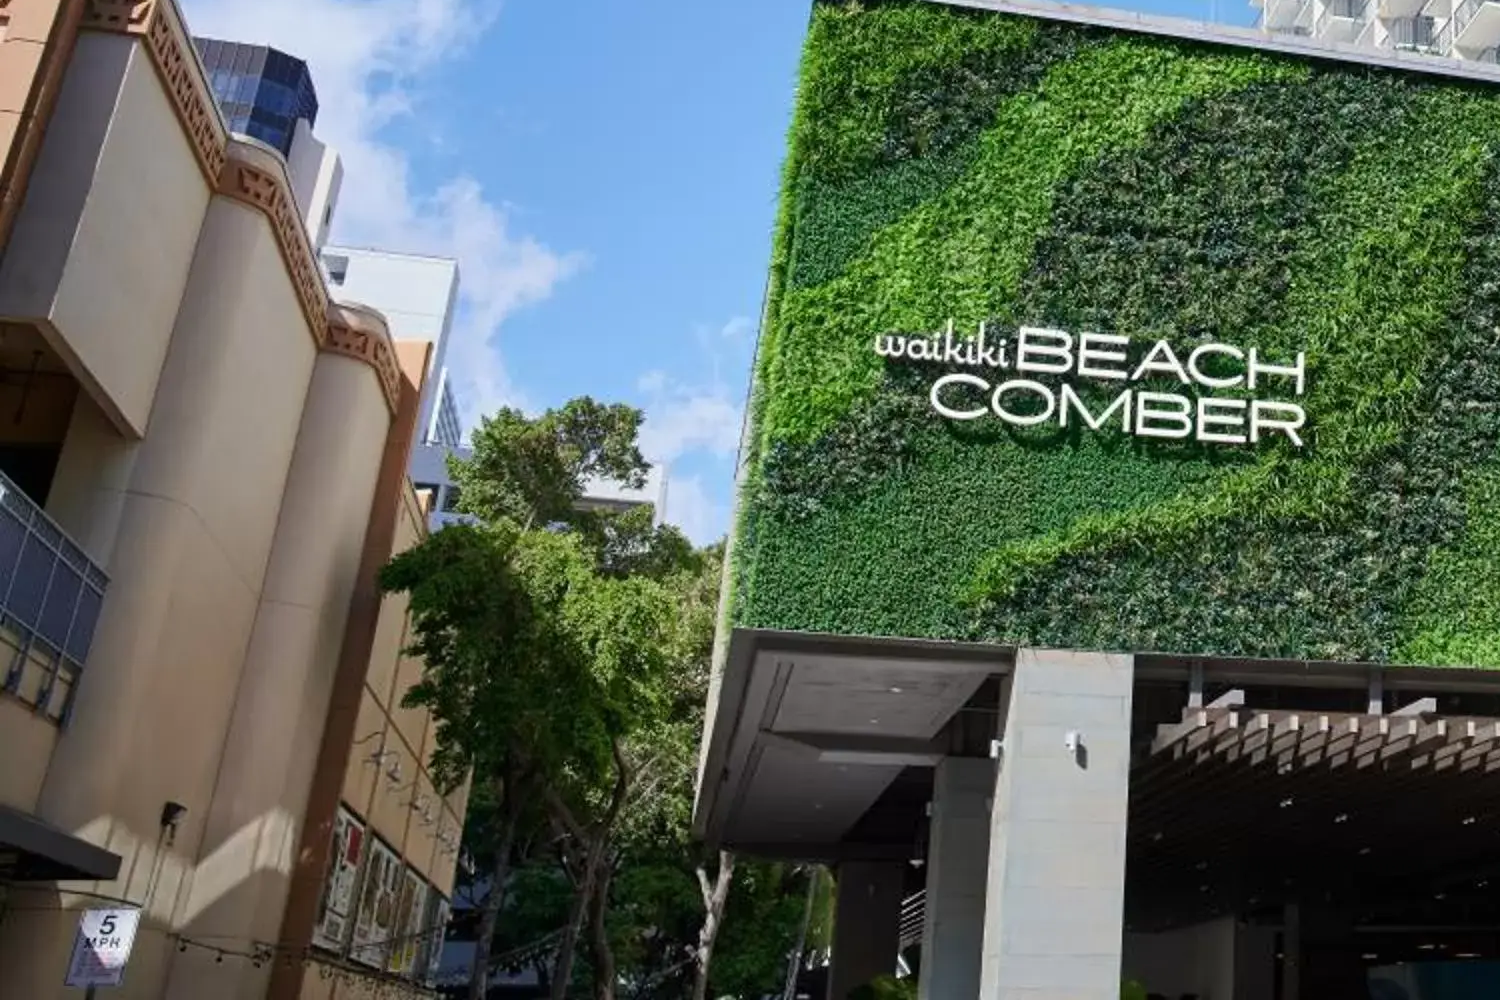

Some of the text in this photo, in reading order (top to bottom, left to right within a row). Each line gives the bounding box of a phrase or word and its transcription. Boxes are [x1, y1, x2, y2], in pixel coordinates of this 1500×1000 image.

[875, 317, 1305, 395] waikiki BEACH
[930, 373, 1307, 447] COMBER
[83, 937, 121, 949] MPH
[99, 915, 119, 935] 5
